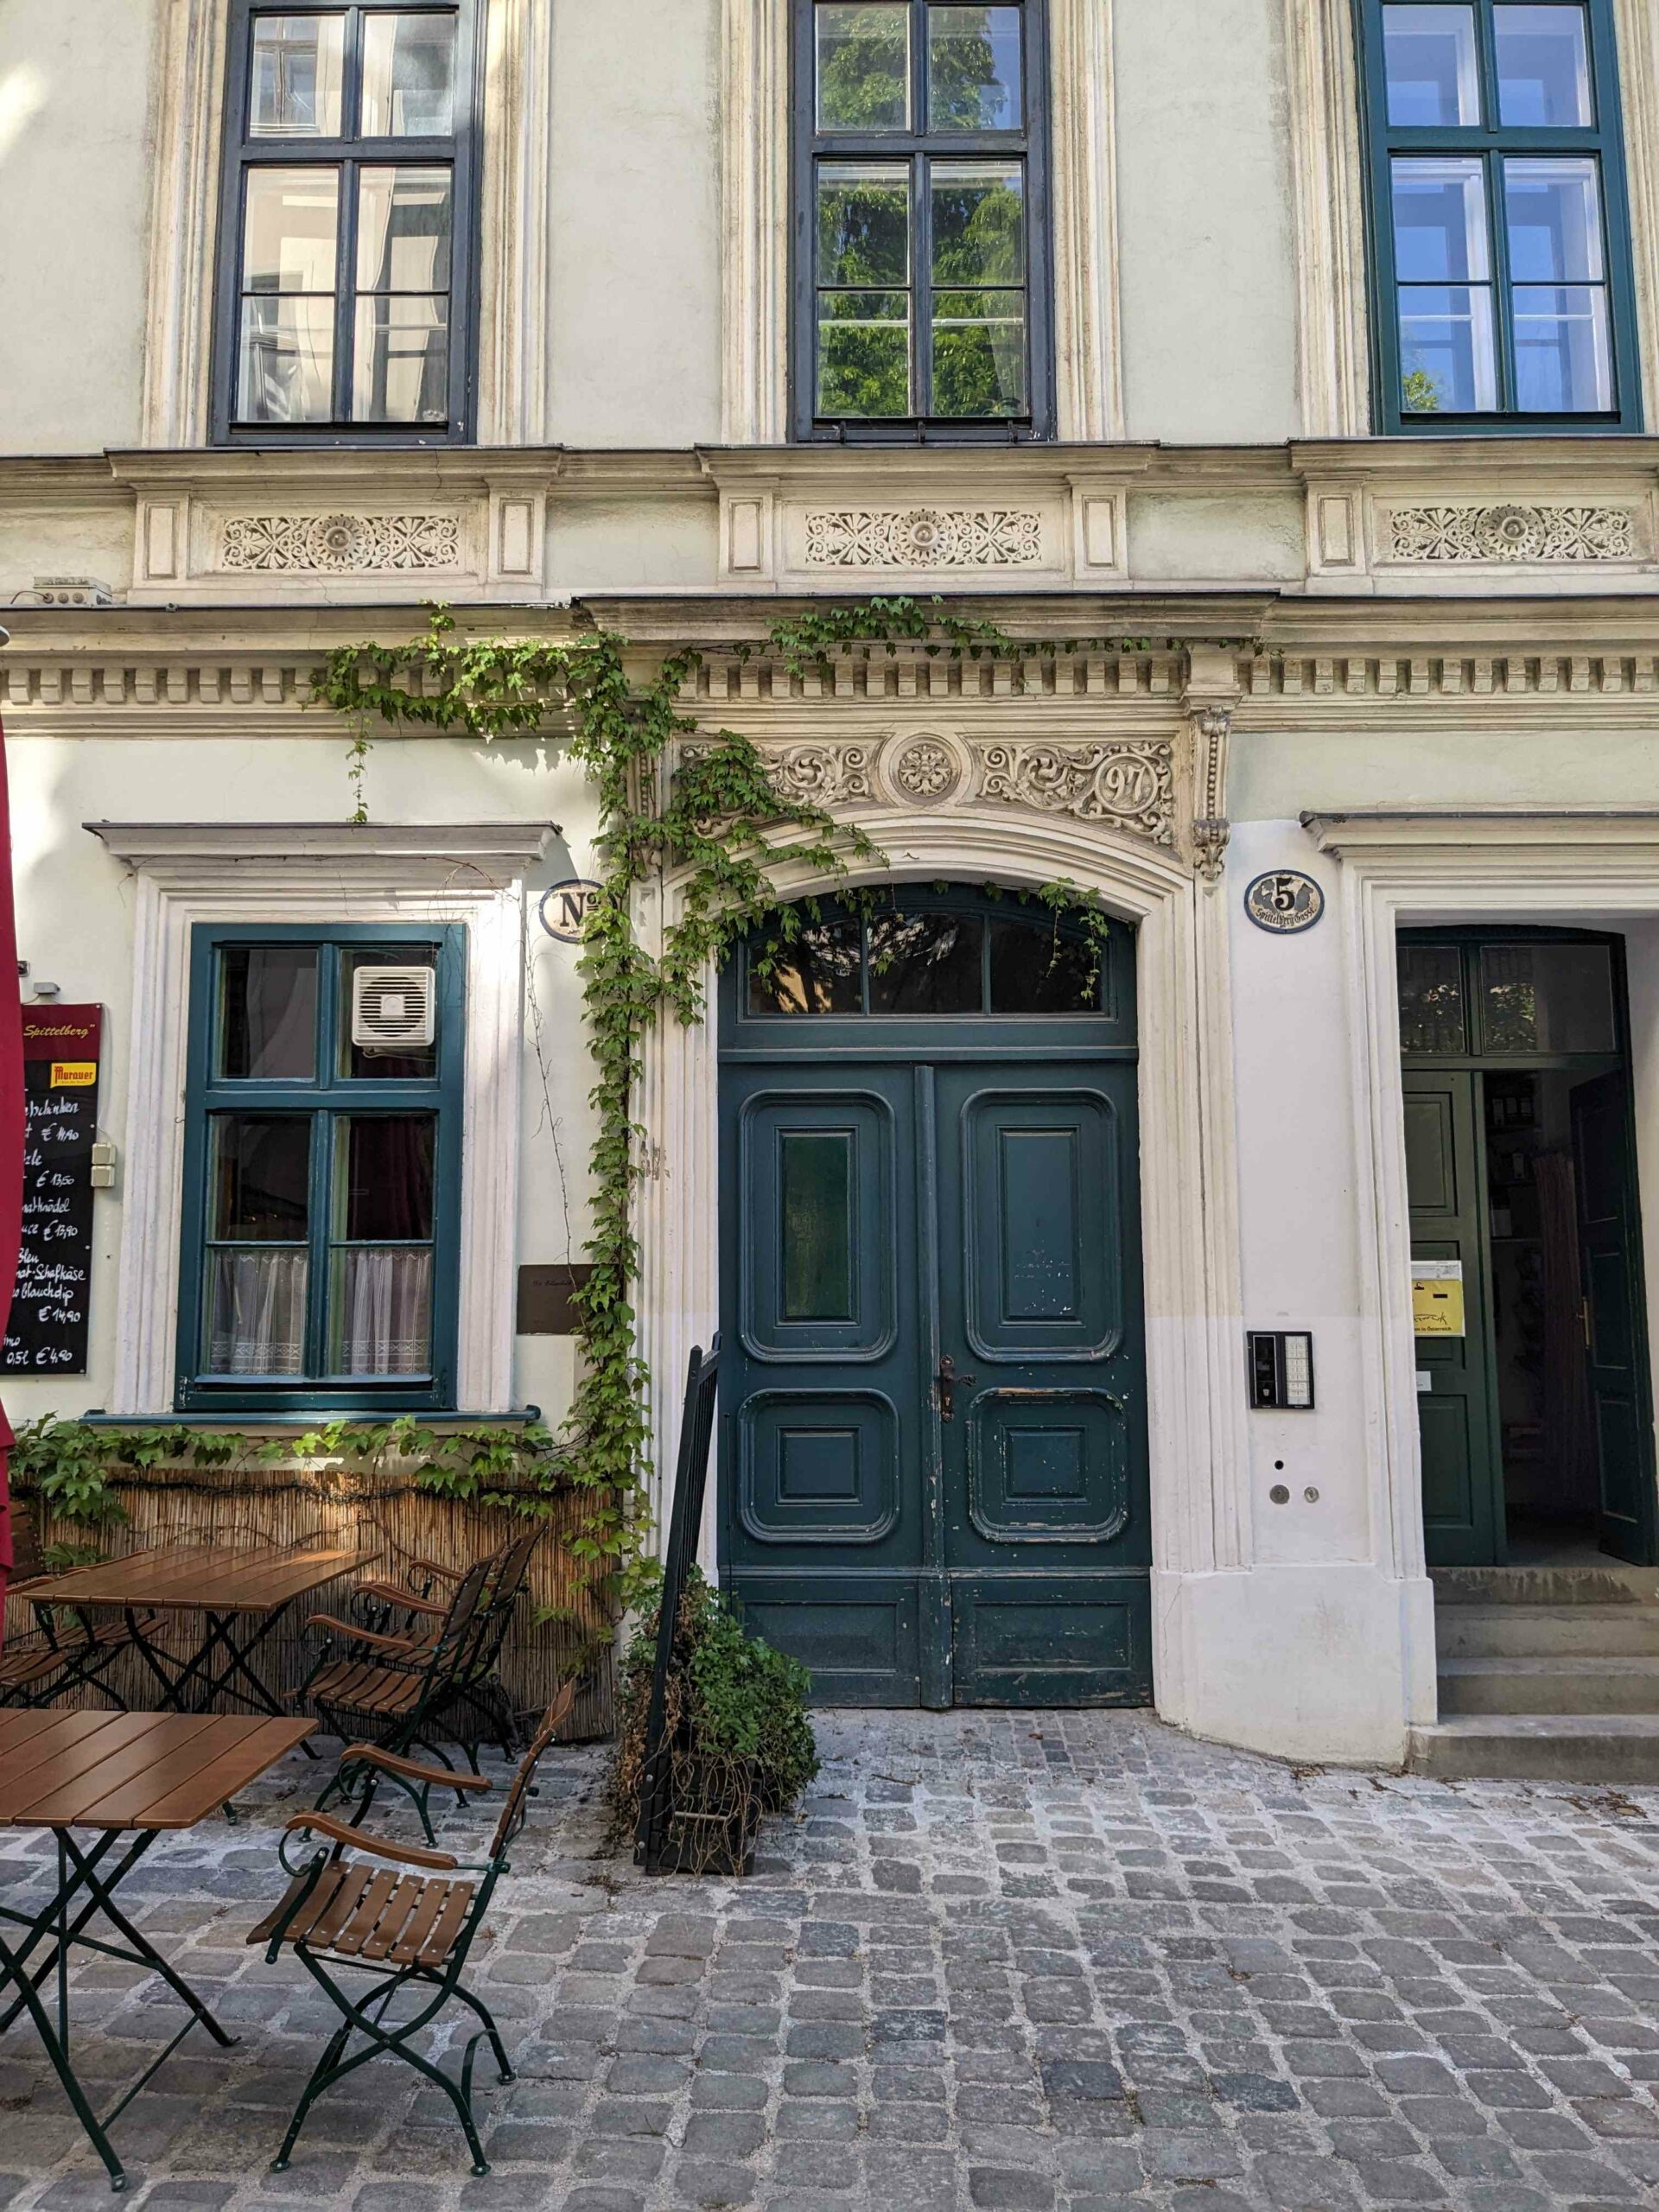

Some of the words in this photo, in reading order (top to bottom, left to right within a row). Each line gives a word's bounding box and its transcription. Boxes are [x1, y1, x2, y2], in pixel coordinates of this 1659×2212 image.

[1106, 764, 1148, 806] 97
[1274, 876, 1295, 912] 5
[54, 1065, 93, 1084] Murauer
[35, 1169, 50, 1188] €
[50, 1173, 75, 1188] 13,50
[22, 1195, 71, 1214] natknödel
[43, 1219, 59, 1242] €
[54, 1224, 79, 1240] 13,90
[16, 1263, 87, 1285] nat-Schafkäse
[12, 1281, 74, 1307] oblauchdip
[38, 1305, 52, 1322] €
[52, 1307, 81, 1325] 14,90
[6, 1349, 29, 1365] 0,5l
[35, 1346, 51, 1365] €
[49, 1348, 73, 1364] 4,90
